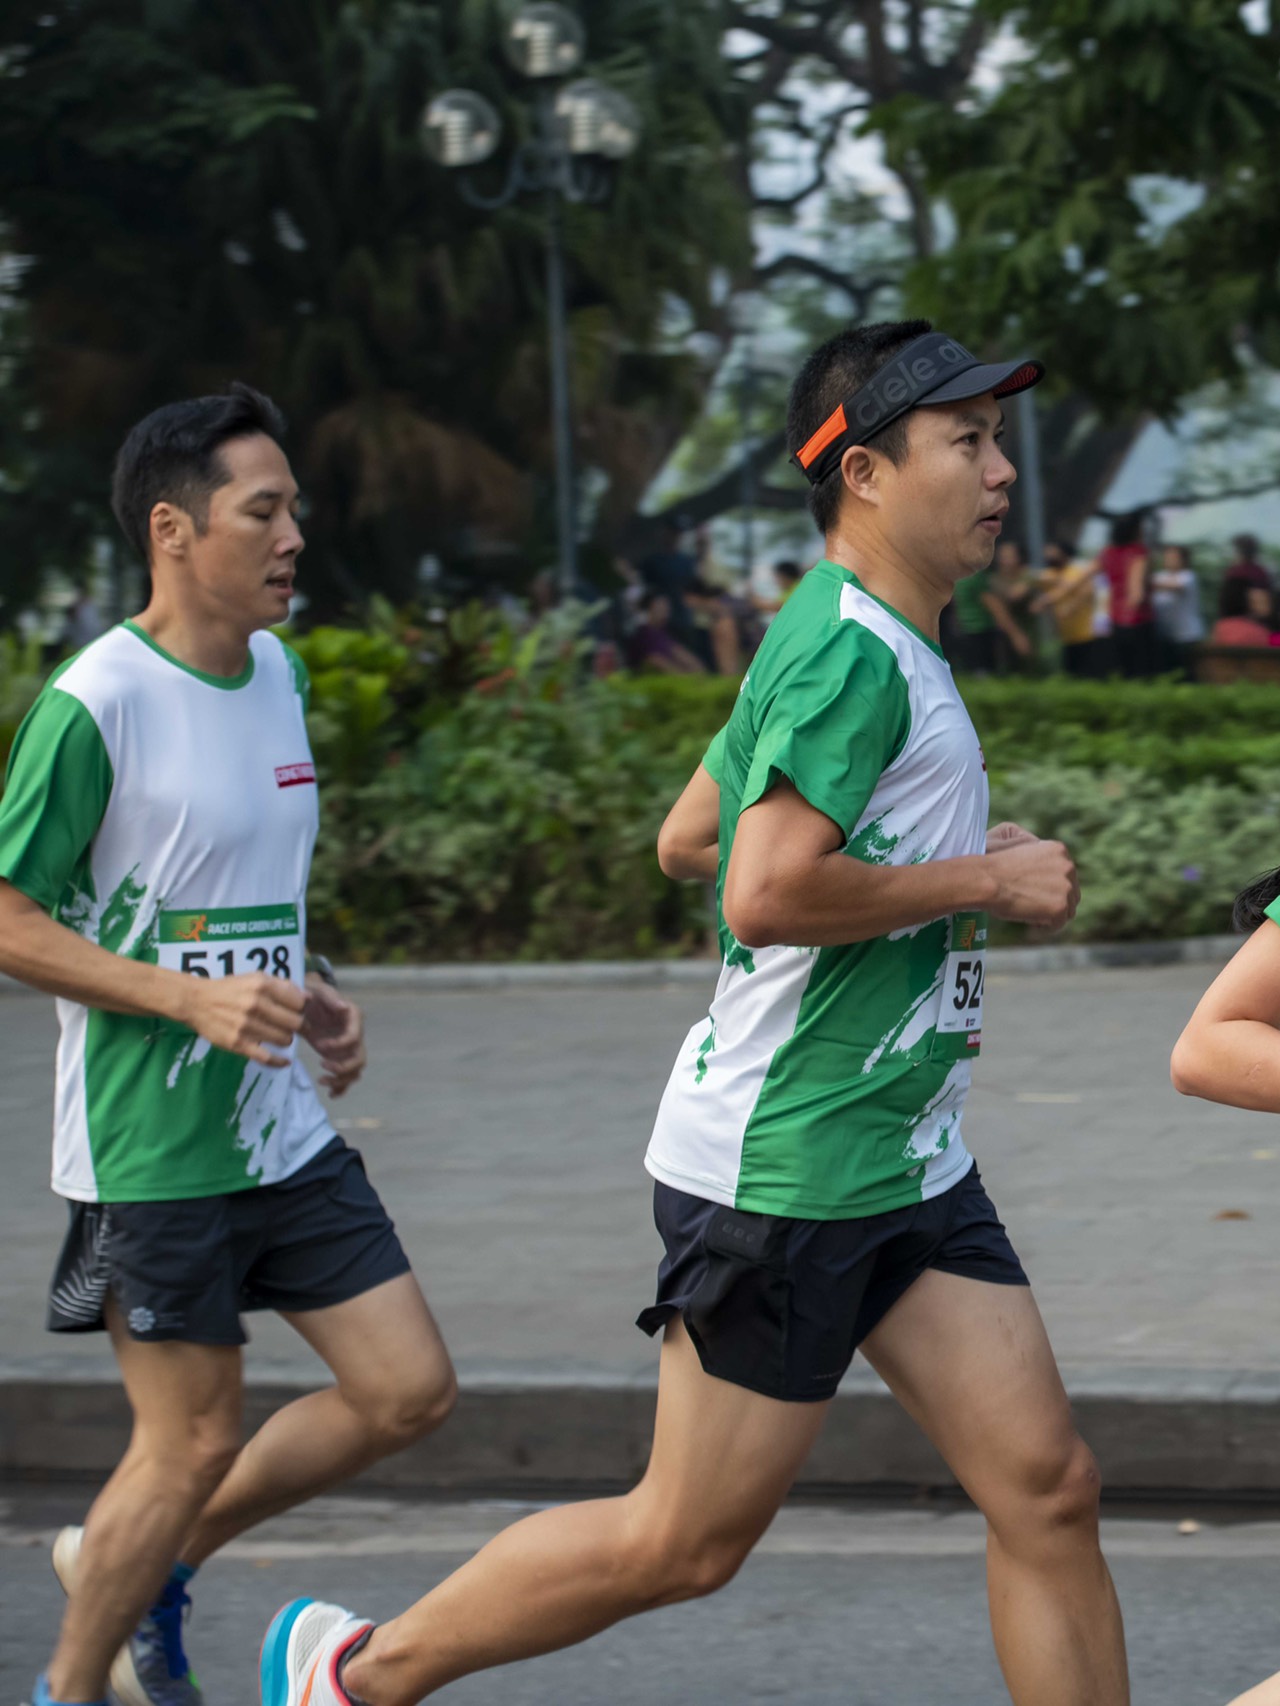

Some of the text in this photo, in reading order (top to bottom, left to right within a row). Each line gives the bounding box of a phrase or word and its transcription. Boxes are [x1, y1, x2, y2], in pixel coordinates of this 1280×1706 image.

[856, 358, 938, 428] ciele
[208, 922, 230, 935] RACE
[231, 921, 247, 934] FOR
[953, 959, 985, 1011] 52
